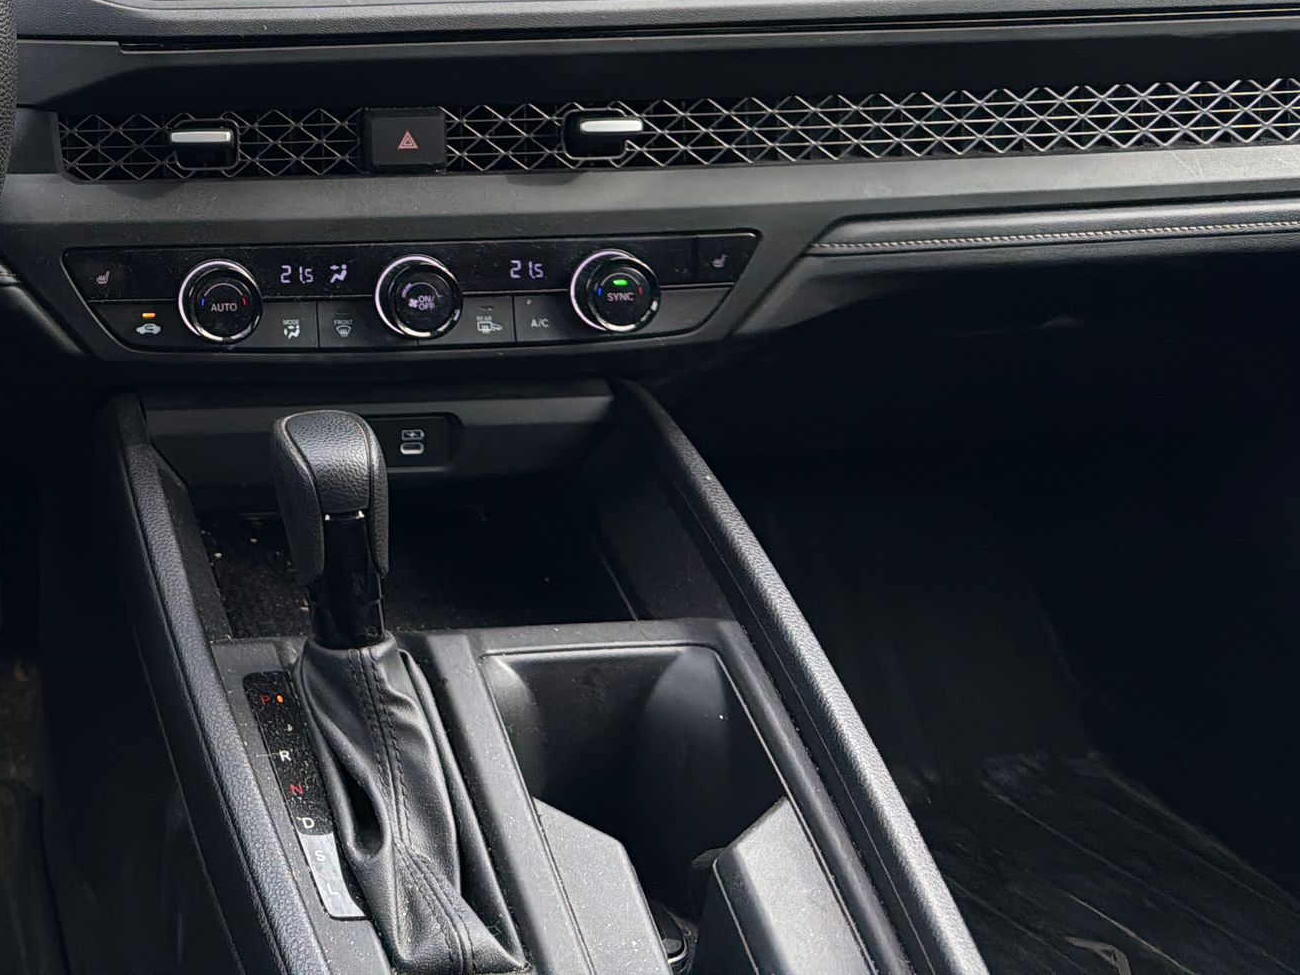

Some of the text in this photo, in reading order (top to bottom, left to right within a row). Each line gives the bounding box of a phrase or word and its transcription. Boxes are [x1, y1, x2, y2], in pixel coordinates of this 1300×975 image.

[606, 292, 636, 302] SYNC
[210, 302, 238, 313] AUTO
[418, 302, 435, 311] OFF
[530, 318, 549, 328] A/C
[279, 751, 292, 762] R
[290, 783, 304, 795] N
[301, 816, 315, 830] D
[314, 849, 326, 862] S
[326, 882, 340, 896] L
